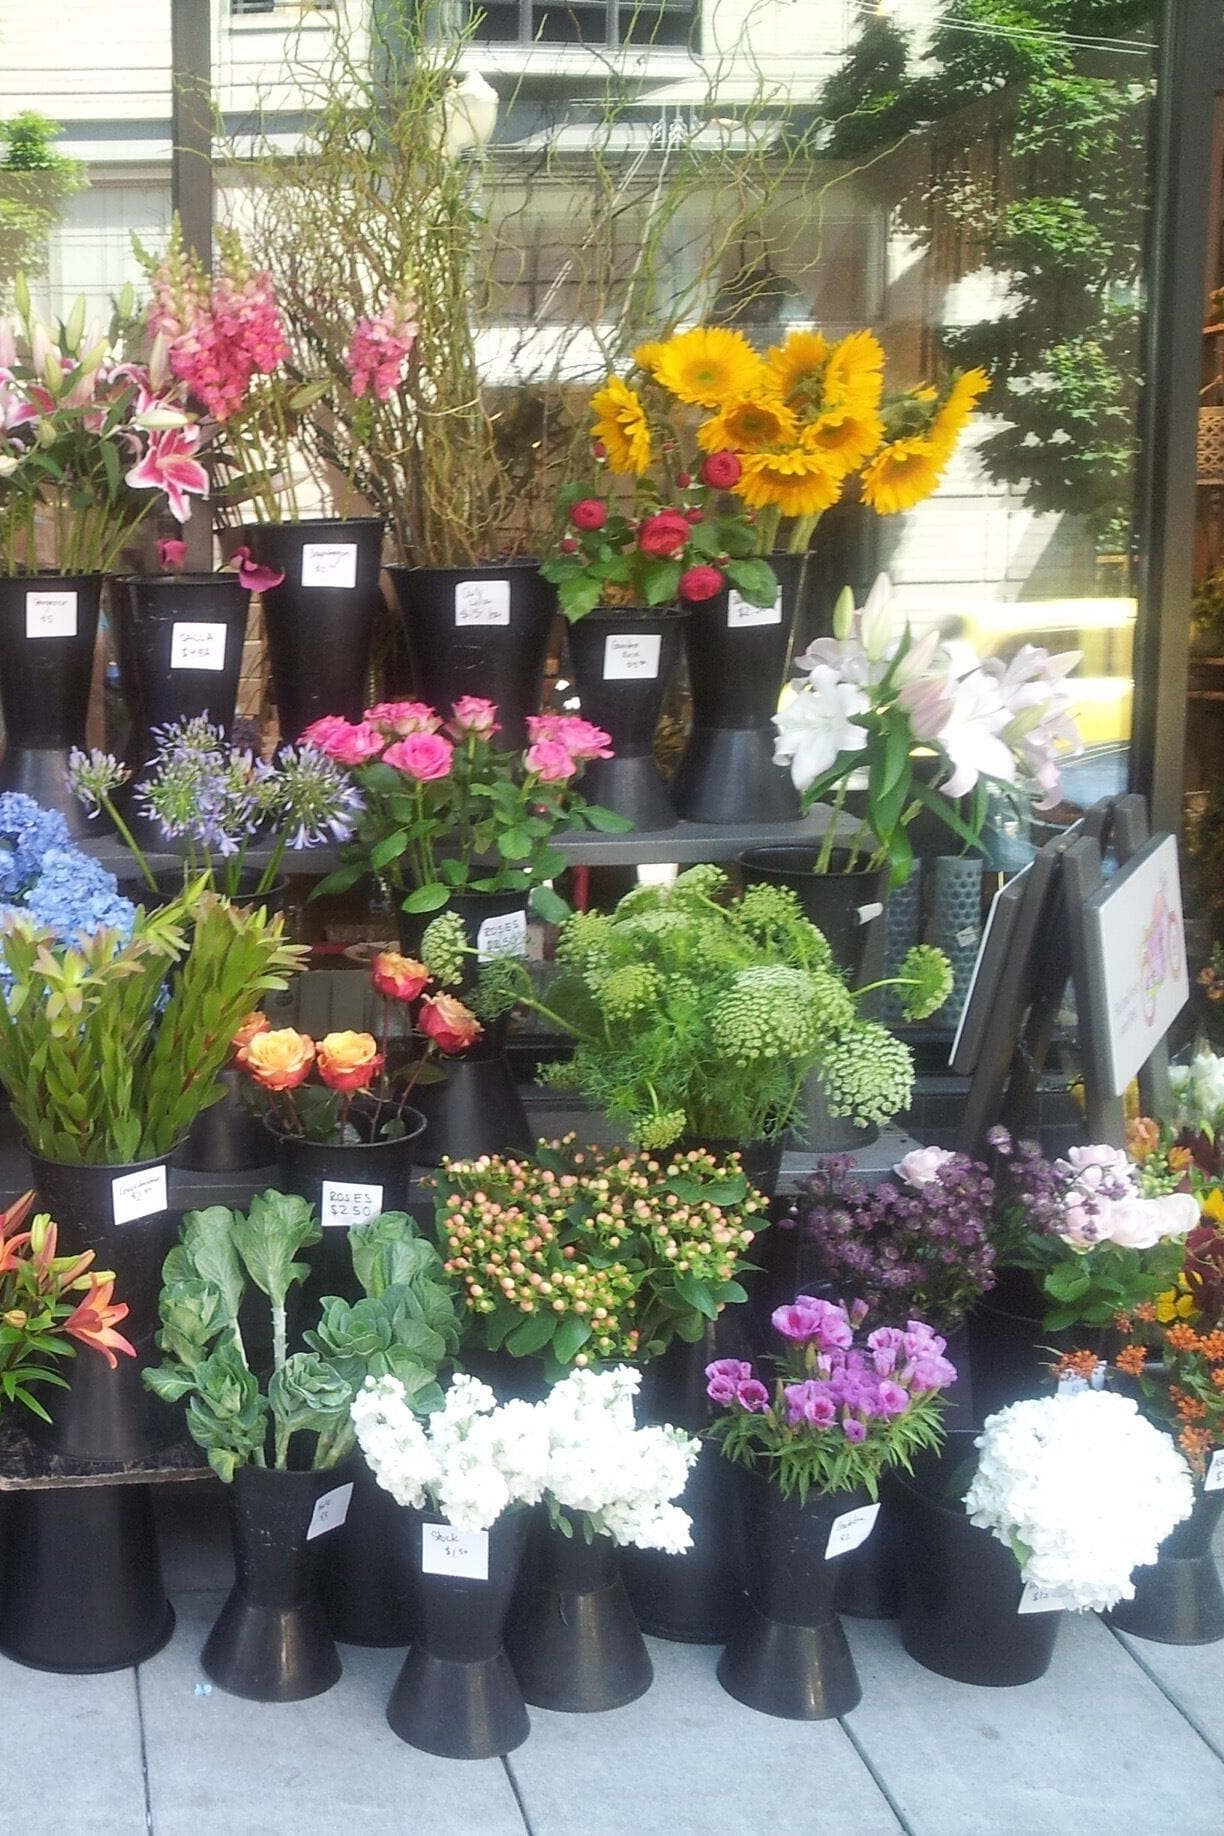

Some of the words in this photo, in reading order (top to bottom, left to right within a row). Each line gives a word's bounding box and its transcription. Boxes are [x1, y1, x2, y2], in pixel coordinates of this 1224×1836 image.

[484, 919, 520, 937] ROSES
[329, 1191, 373, 1204] ROSES
[431, 1530, 459, 1543] Stock
